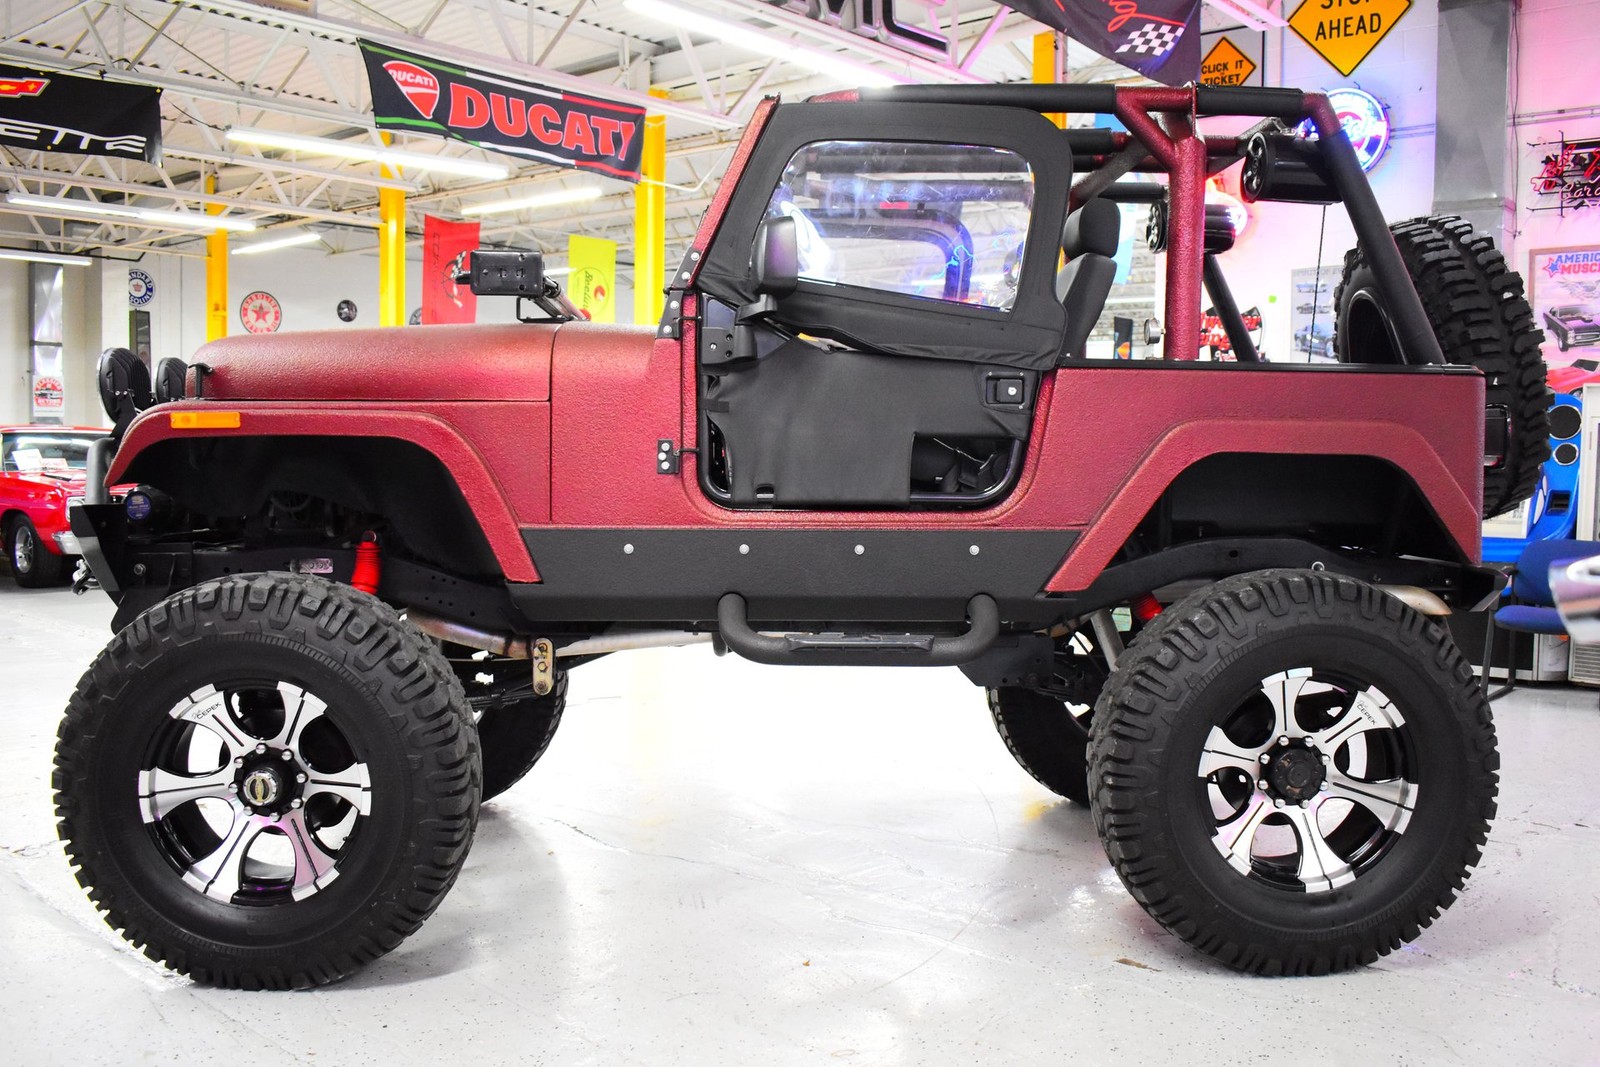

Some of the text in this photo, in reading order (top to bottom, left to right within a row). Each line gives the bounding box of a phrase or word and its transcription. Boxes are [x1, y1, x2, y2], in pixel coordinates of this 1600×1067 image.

[1315, 13, 1382, 42] AHEAD
[1201, 60, 1244, 75] CLICK IT
[388, 69, 434, 88] DUCATI
[1204, 74, 1241, 85] TICKET
[448, 82, 635, 162] DUCATI
[1560, 263, 1600, 274] MUSC
[197, 702, 221, 720] CEPEK
[1357, 704, 1375, 725] CEPEK
